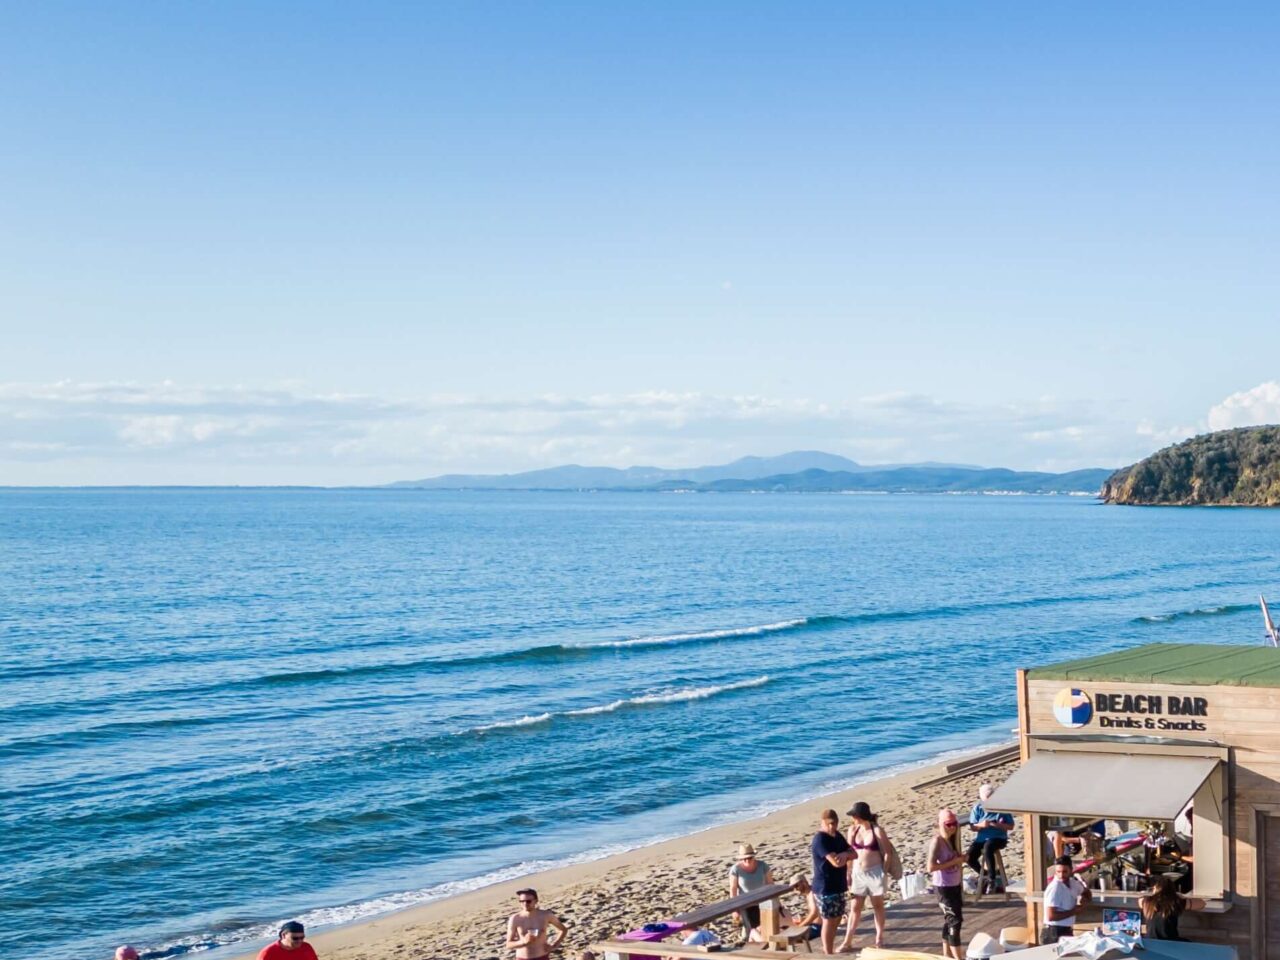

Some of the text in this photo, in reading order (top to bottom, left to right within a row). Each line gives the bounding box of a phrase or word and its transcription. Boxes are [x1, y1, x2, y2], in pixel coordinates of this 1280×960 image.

[1095, 693, 1208, 716] BEACH BAR
[1099, 716, 1207, 731] Drinks & Snacks
